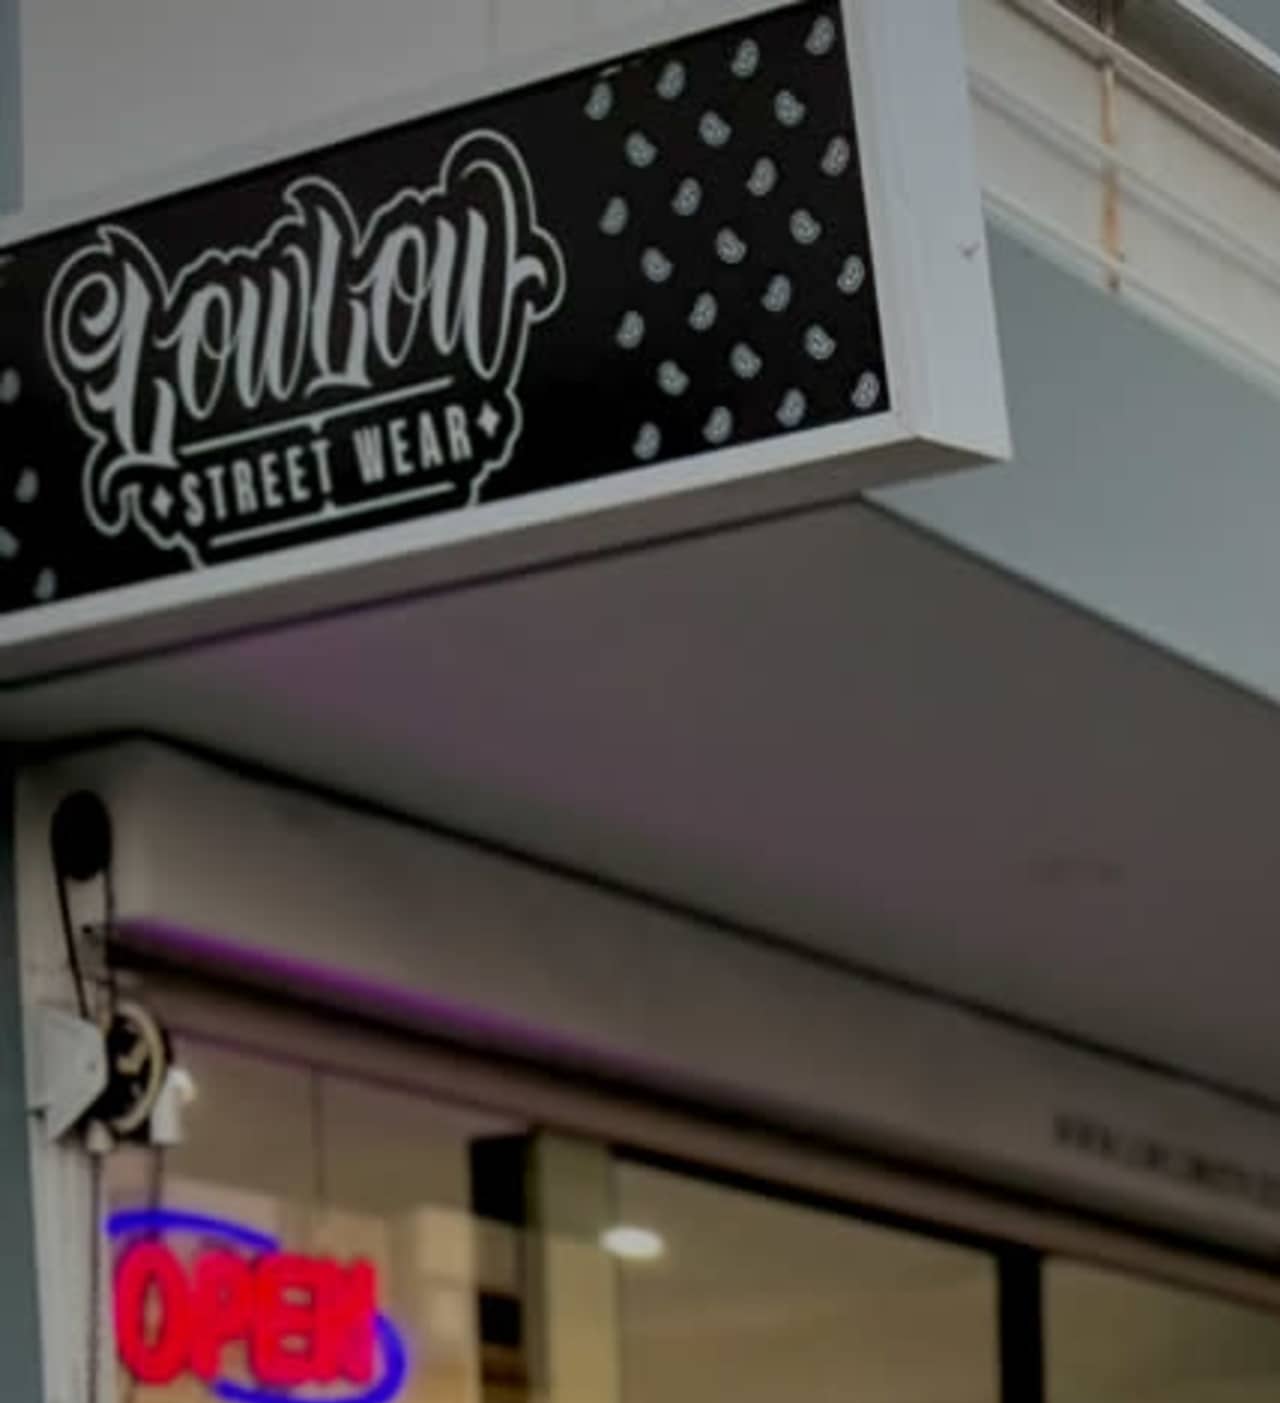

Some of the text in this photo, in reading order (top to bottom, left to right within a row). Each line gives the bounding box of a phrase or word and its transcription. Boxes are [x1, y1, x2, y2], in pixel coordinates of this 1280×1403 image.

[182, 403, 473, 525] STREET WEAR
[113, 1239, 378, 1386] OPEN
